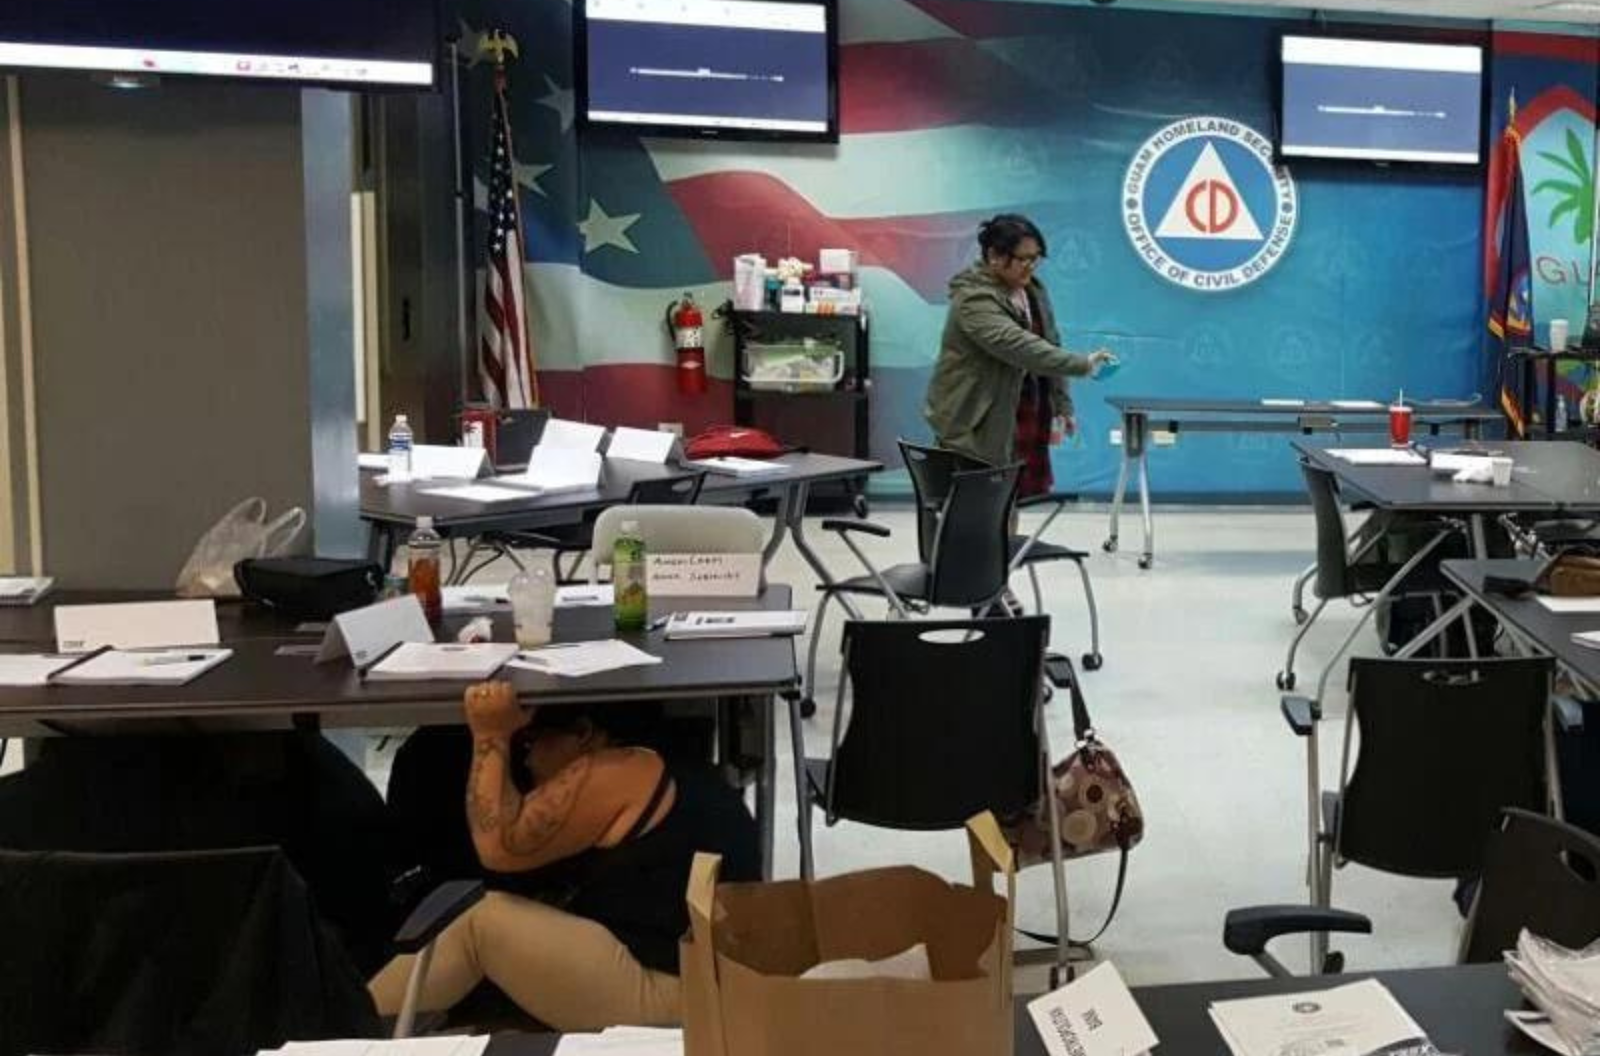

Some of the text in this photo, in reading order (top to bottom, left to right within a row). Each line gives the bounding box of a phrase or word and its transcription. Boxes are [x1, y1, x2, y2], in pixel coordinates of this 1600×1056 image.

[1128, 148, 1151, 194] GUAM
[1153, 121, 1239, 149] HOMELAND
[1185, 180, 1238, 233] CD
[1128, 213, 1293, 287] OFFICE OF CIVIL DEFENSE
